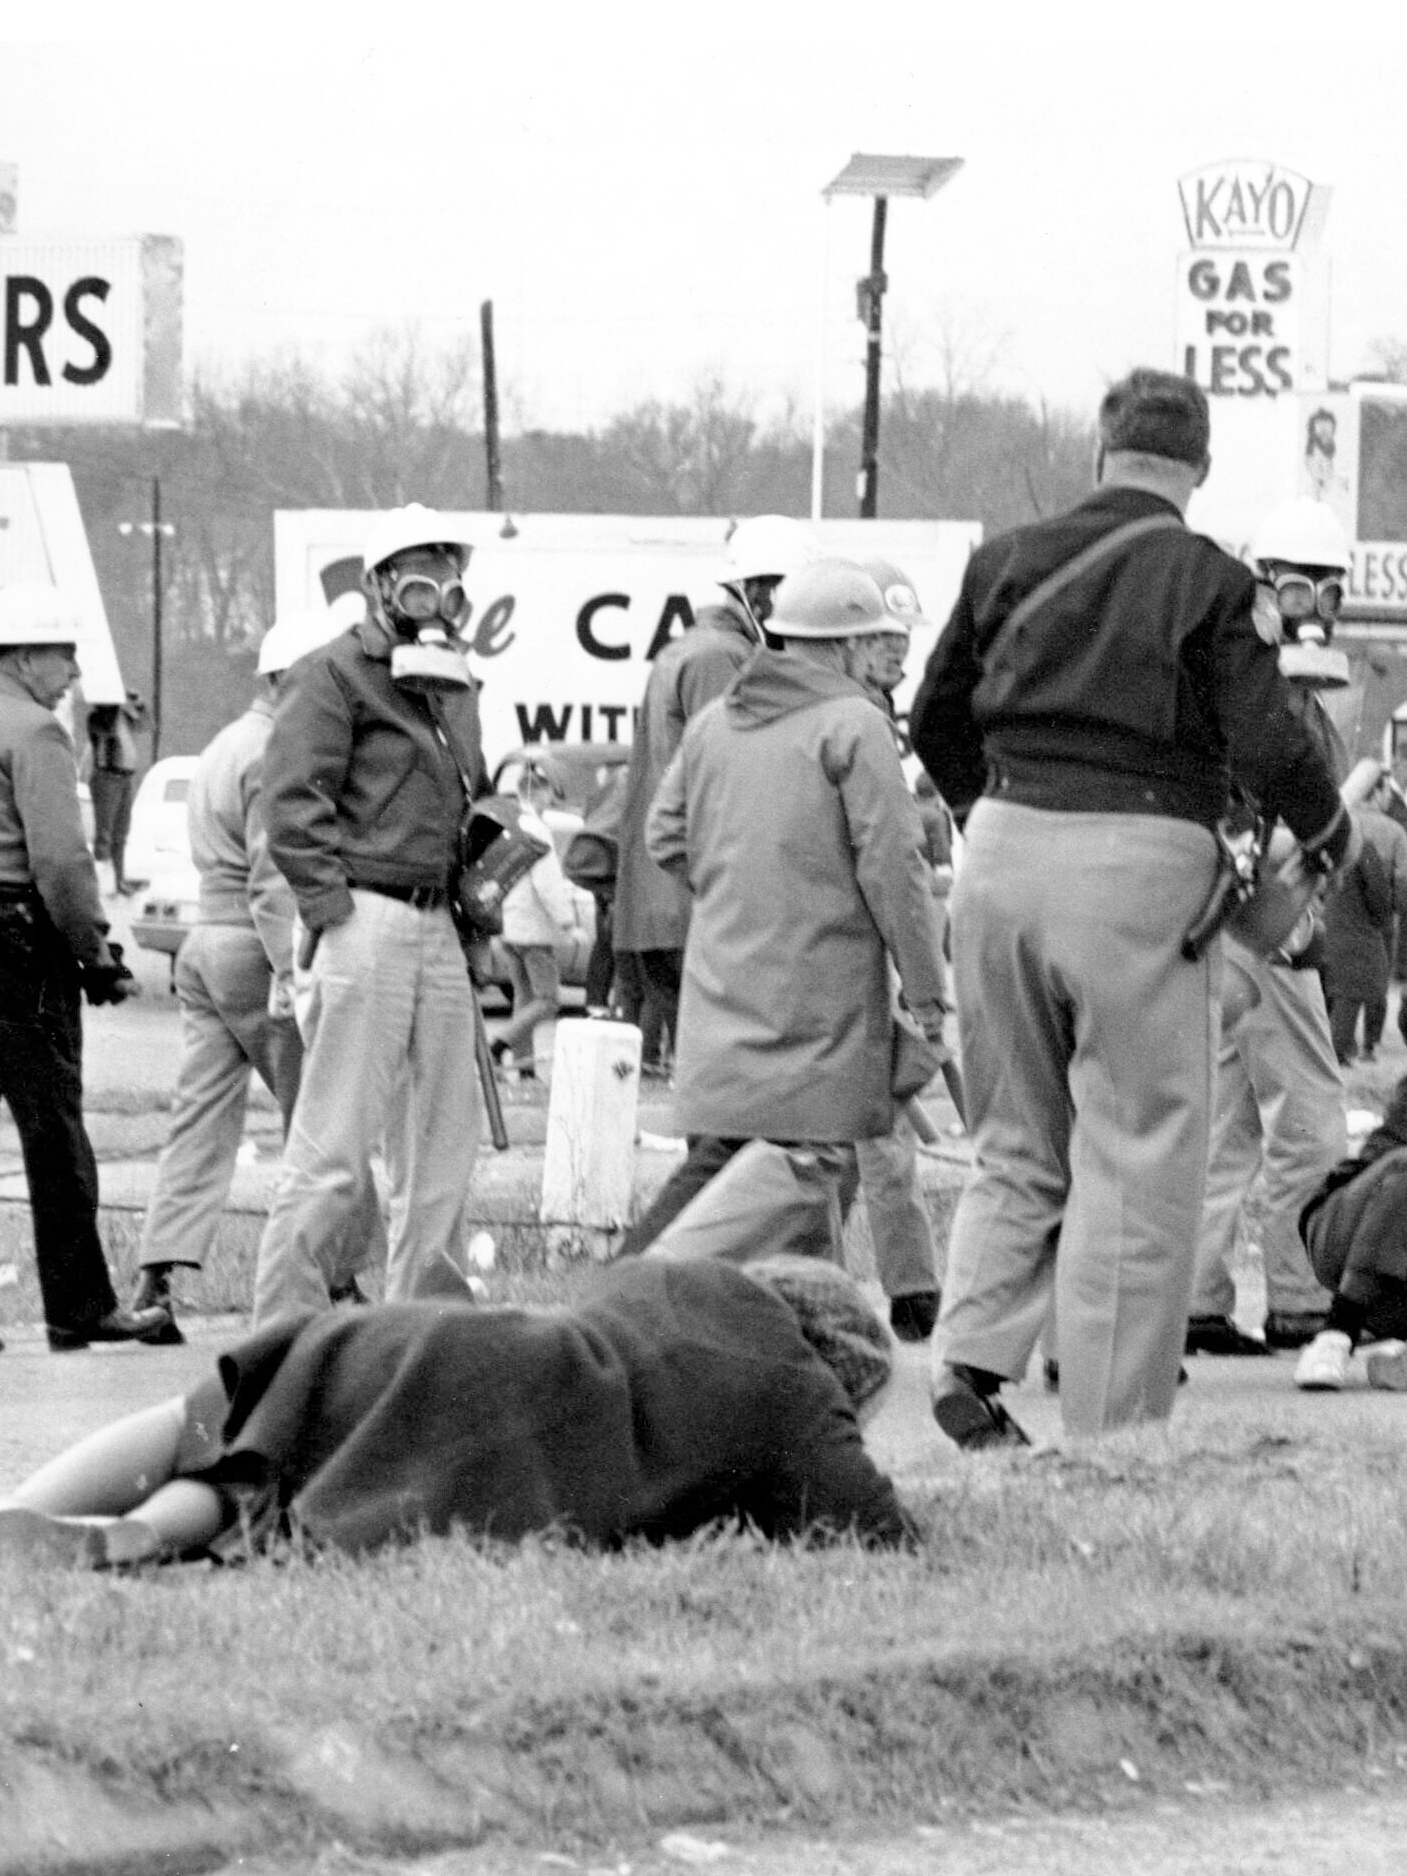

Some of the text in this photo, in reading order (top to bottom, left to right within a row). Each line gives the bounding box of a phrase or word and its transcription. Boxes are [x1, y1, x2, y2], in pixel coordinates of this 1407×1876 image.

[1196, 167, 1295, 240] KAYO
[1188, 258, 1293, 303] GAS
[4, 274, 112, 387] RS
[1206, 309, 1274, 338] FOR
[1184, 344, 1293, 398] LESS
